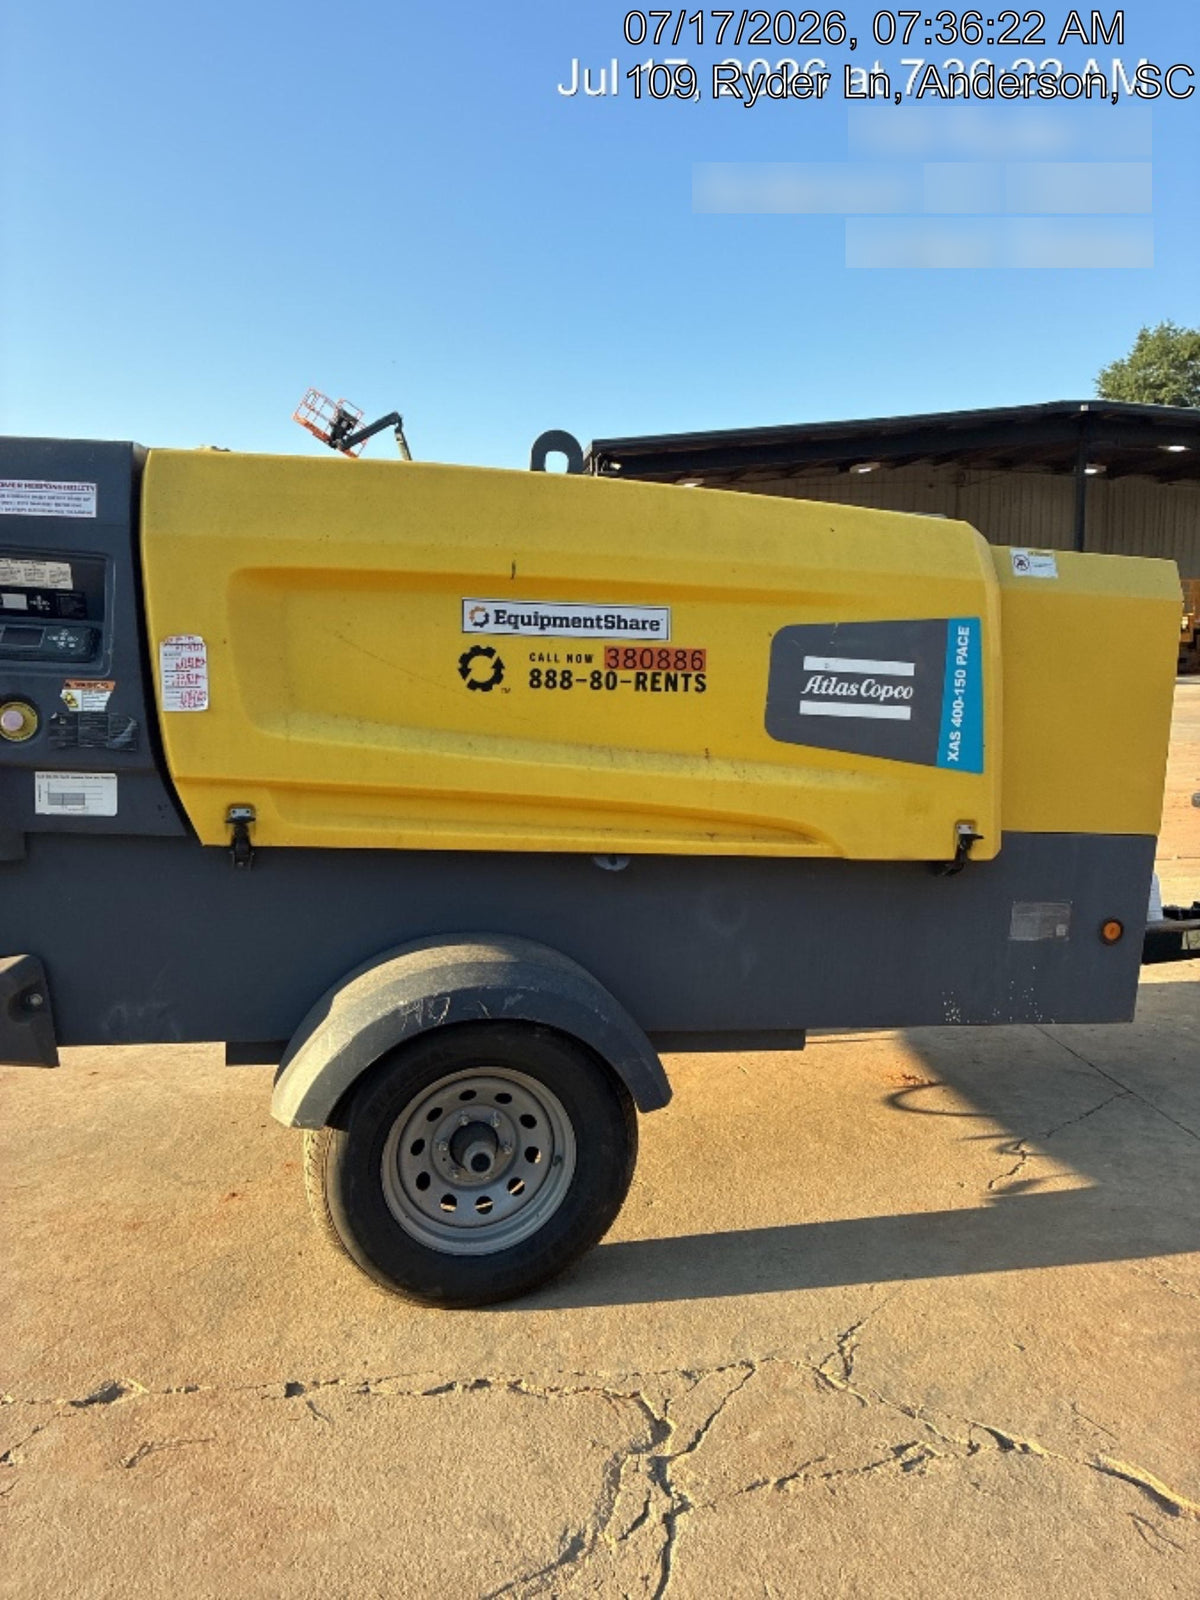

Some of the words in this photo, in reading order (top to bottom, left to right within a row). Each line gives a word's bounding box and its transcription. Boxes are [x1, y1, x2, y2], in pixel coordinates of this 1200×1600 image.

[493, 609, 661, 632] EquipmentShare
[529, 652, 560, 663] CALL
[566, 653, 594, 664] NOW
[956, 625, 971, 666] PACE
[606, 647, 704, 671] 380886
[529, 668, 707, 693] 888-80-RENTS
[950, 669, 968, 728] 400-150
[947, 731, 961, 762] XAS
